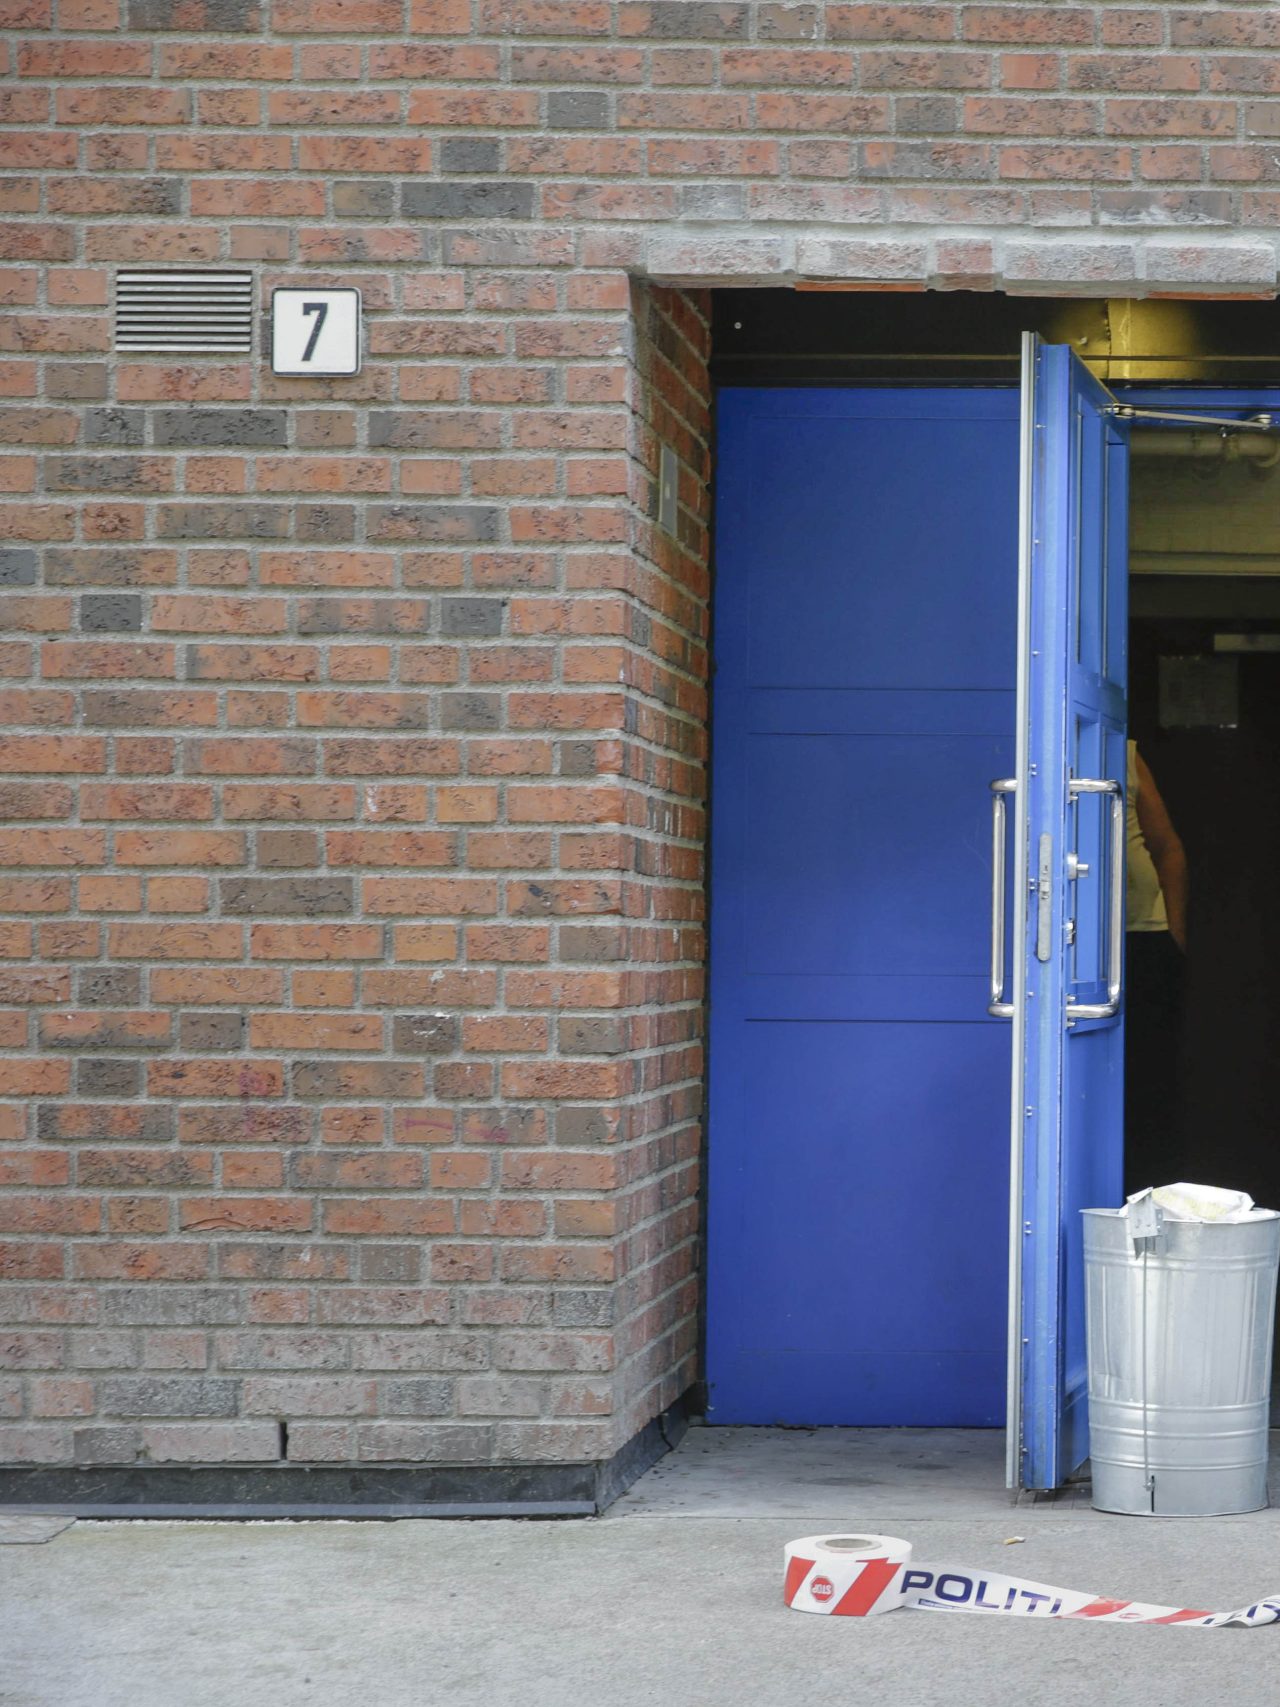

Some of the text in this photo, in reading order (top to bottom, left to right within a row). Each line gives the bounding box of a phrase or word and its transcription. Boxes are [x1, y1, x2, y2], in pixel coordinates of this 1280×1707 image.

[301, 302, 328, 361] 7
[811, 1583, 832, 1595] STOP
[900, 1570, 1063, 1614] POLITI
